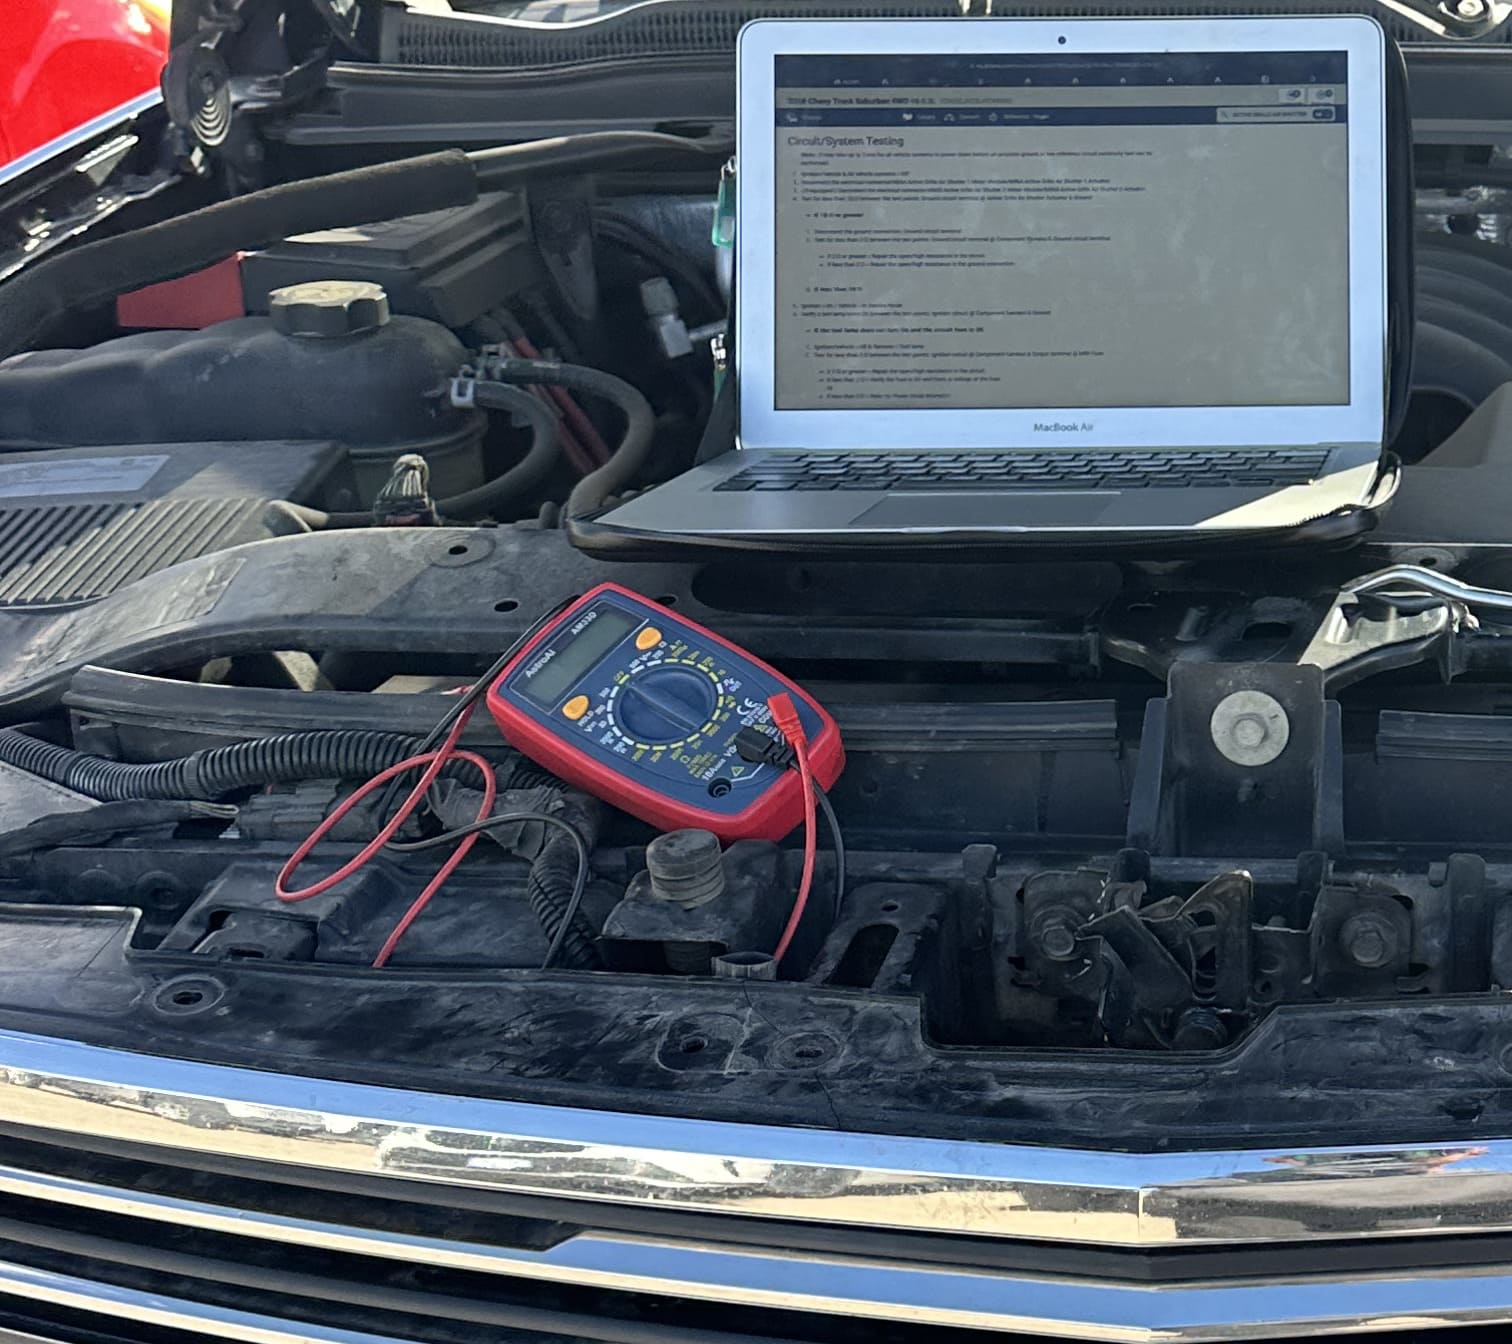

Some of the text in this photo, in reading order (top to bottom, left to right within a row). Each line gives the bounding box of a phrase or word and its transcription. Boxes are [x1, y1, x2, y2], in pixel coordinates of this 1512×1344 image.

[787, 136, 904, 148] Circuit/System Testing
[1033, 422, 1094, 432] MacBook Air
[525, 649, 557, 679] AstroAI
